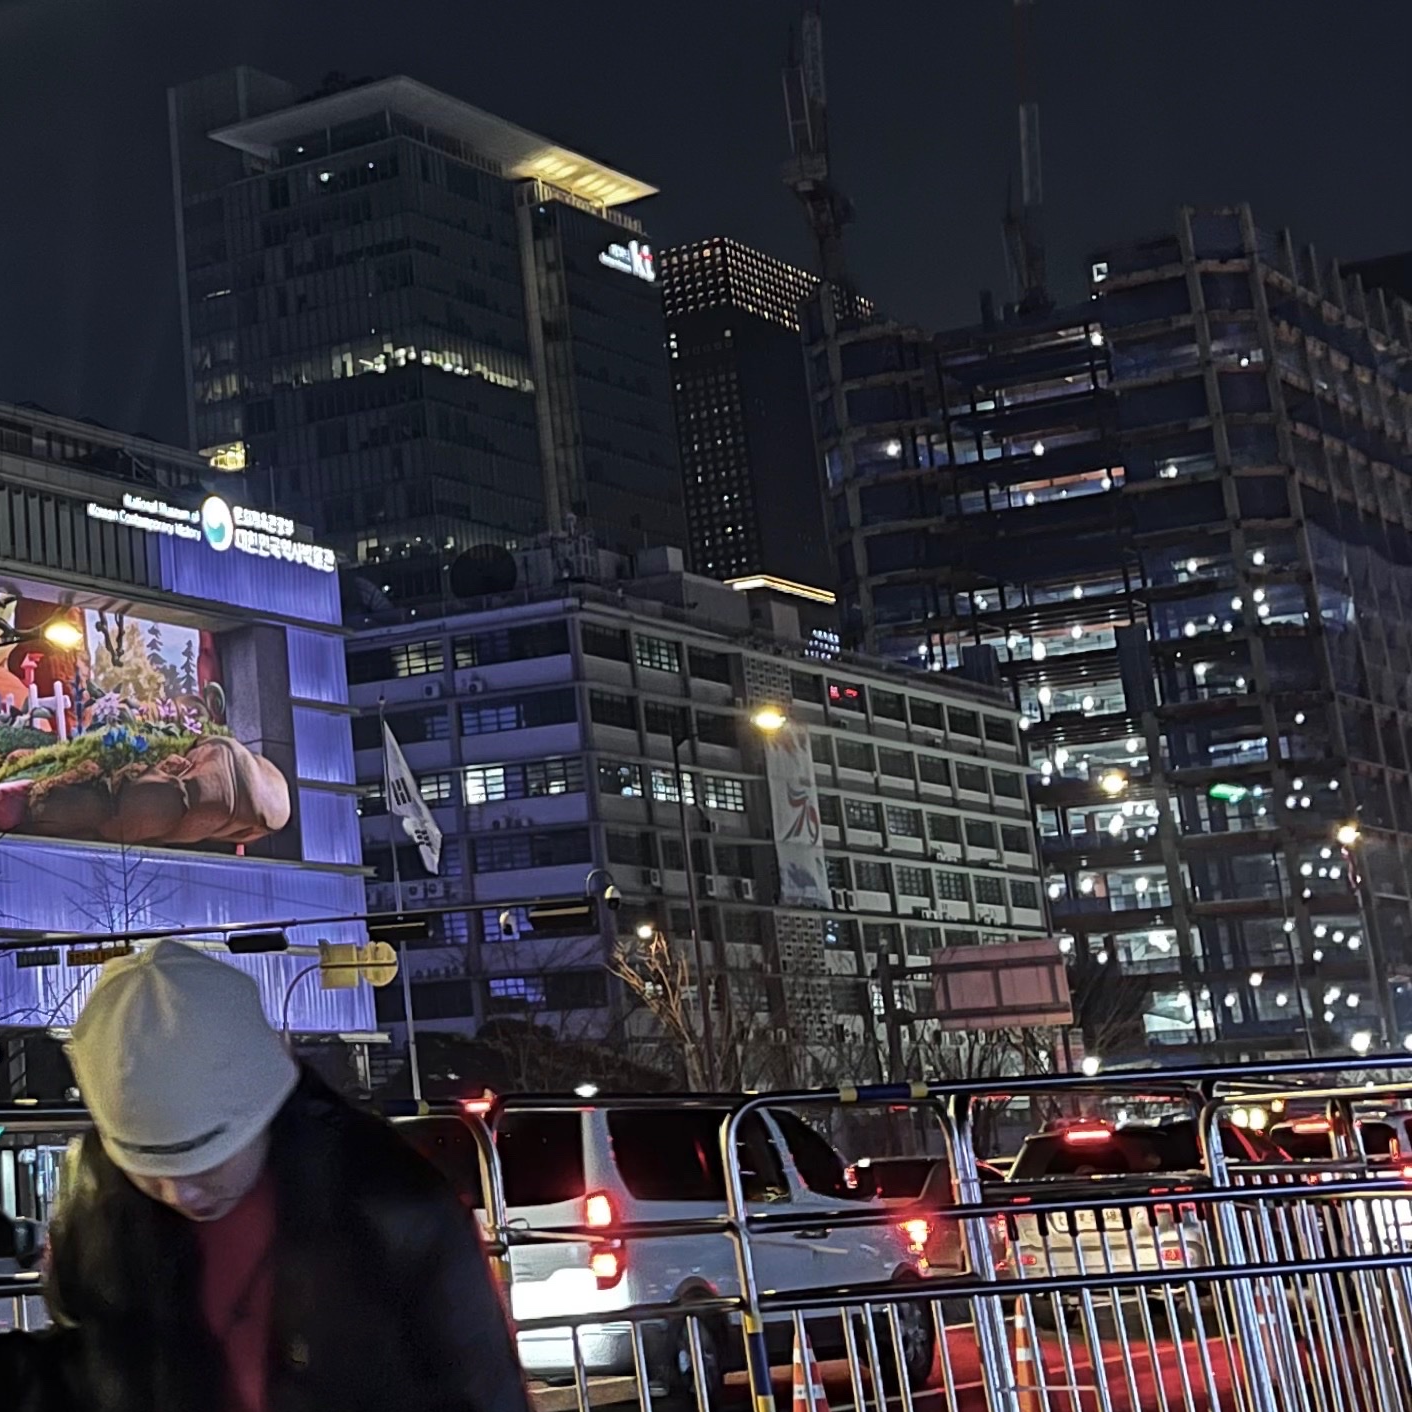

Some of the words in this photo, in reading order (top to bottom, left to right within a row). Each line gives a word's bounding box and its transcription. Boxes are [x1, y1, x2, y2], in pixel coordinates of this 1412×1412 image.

[87, 503, 118, 522] Korean
[118, 509, 174, 536] Contemporary
[175, 522, 201, 542] History
[234, 528, 336, 573] 대한민국역사박물관
